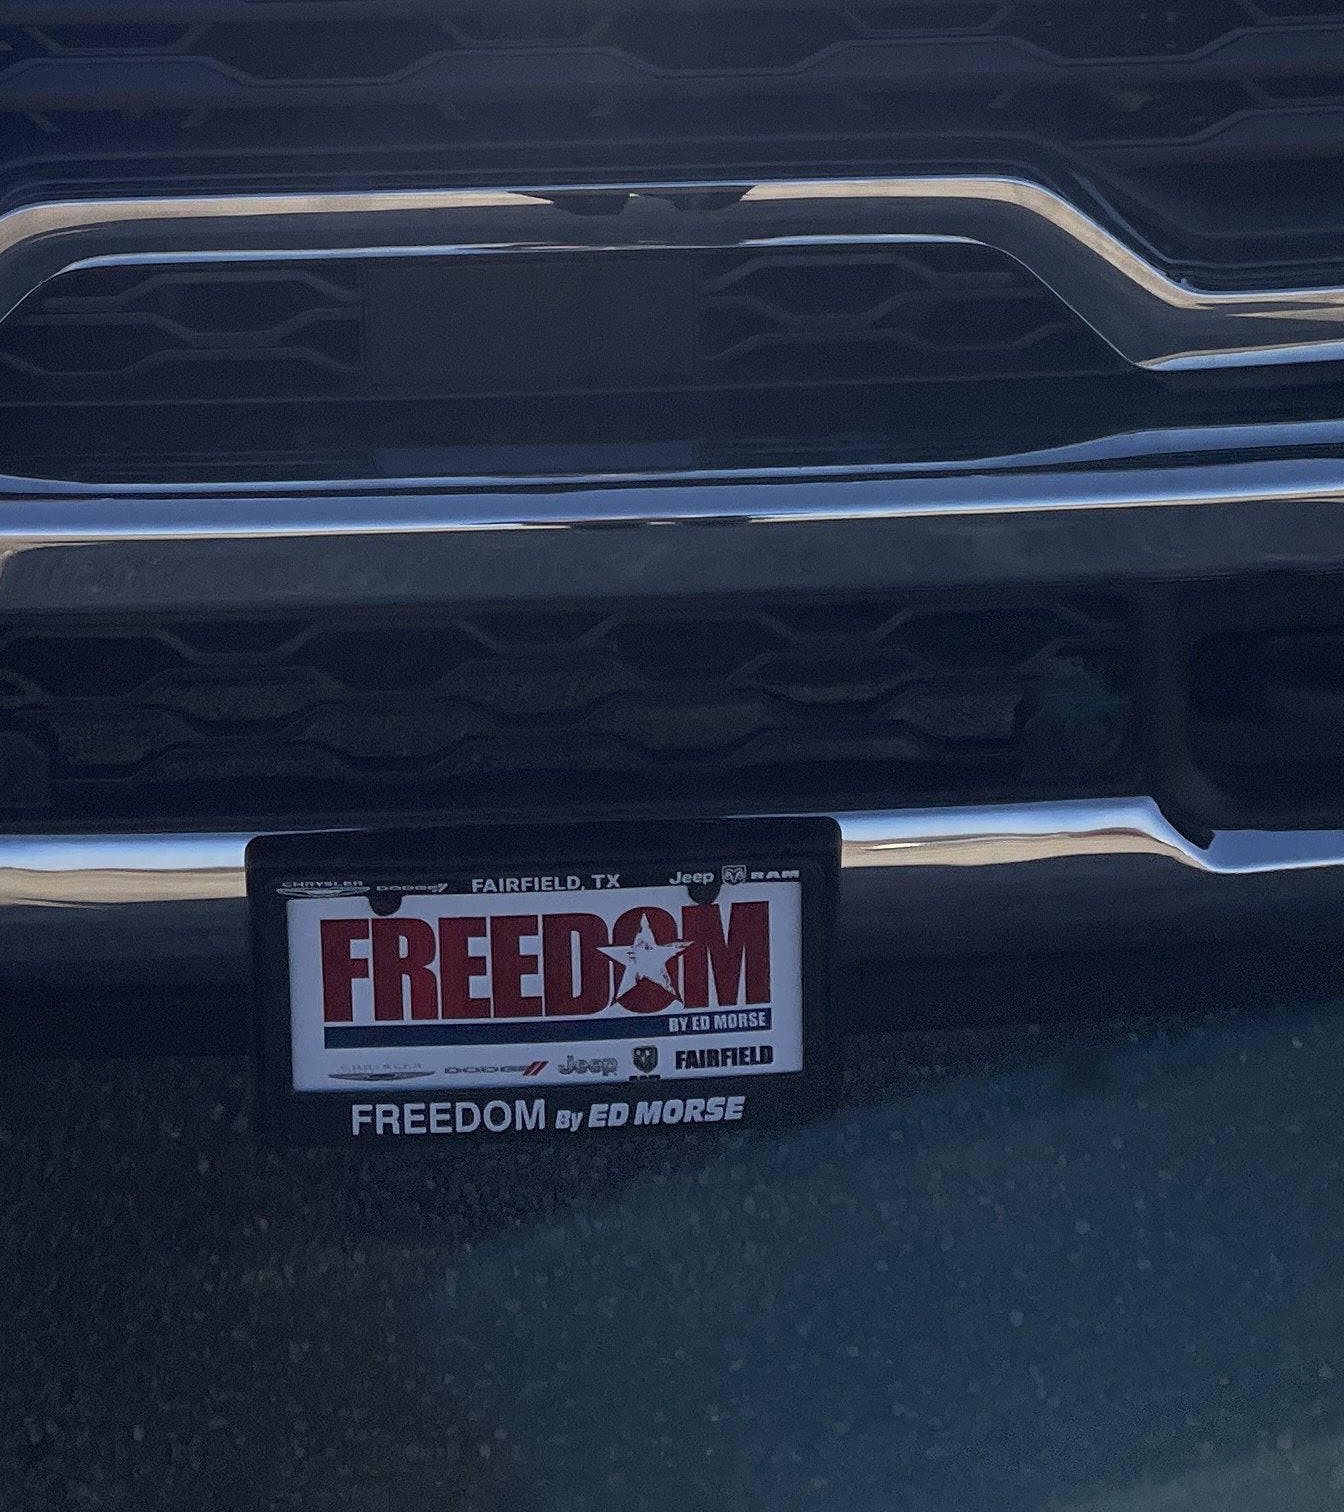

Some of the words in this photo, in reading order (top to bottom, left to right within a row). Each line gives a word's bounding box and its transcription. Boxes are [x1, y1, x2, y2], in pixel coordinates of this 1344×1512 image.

[471, 875, 585, 893] FAIRFIELD,
[592, 873, 621, 888] TX
[669, 871, 714, 886] Jeep
[750, 869, 800, 880] RAM
[320, 900, 772, 1022] FREEDOM
[669, 1017, 688, 1033] BY
[692, 1015, 710, 1031] ED
[714, 1011, 767, 1030] MORSE
[558, 1055, 618, 1076] Jeep
[675, 1045, 774, 1070] FAIRFIELD
[352, 1099, 546, 1136] FREEDOM
[555, 1109, 583, 1133] By
[588, 1102, 629, 1128] ED
[634, 1096, 747, 1126] MORSE
